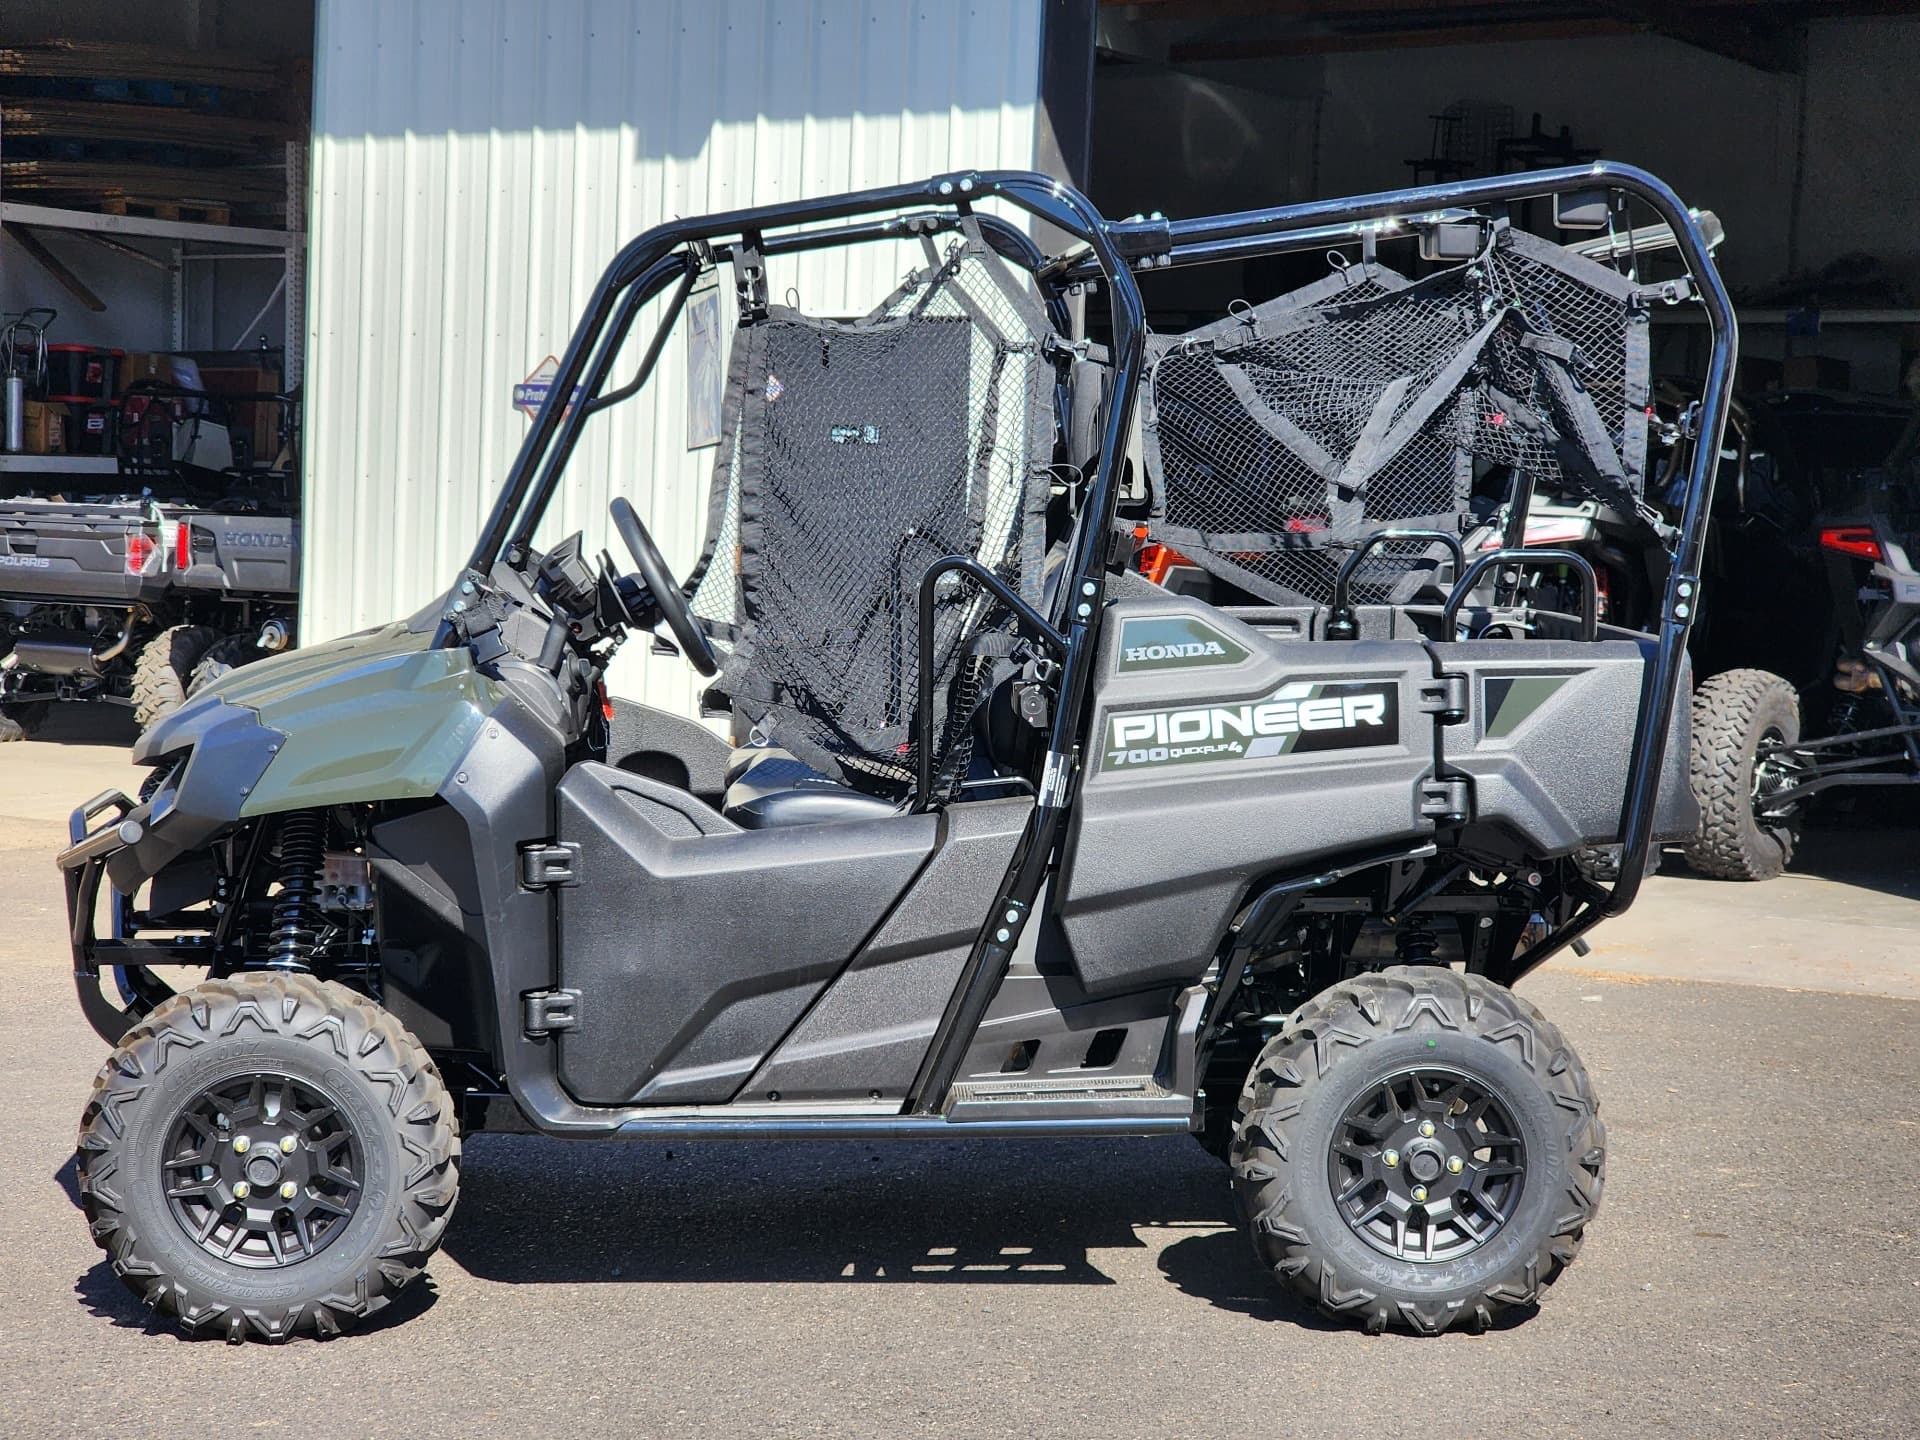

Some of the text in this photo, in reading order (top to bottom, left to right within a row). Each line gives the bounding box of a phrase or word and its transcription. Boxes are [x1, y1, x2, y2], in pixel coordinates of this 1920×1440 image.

[1125, 641, 1226, 662] HONDA
[1113, 693, 1386, 748] PIONEER
[1107, 747, 1169, 765] 700
